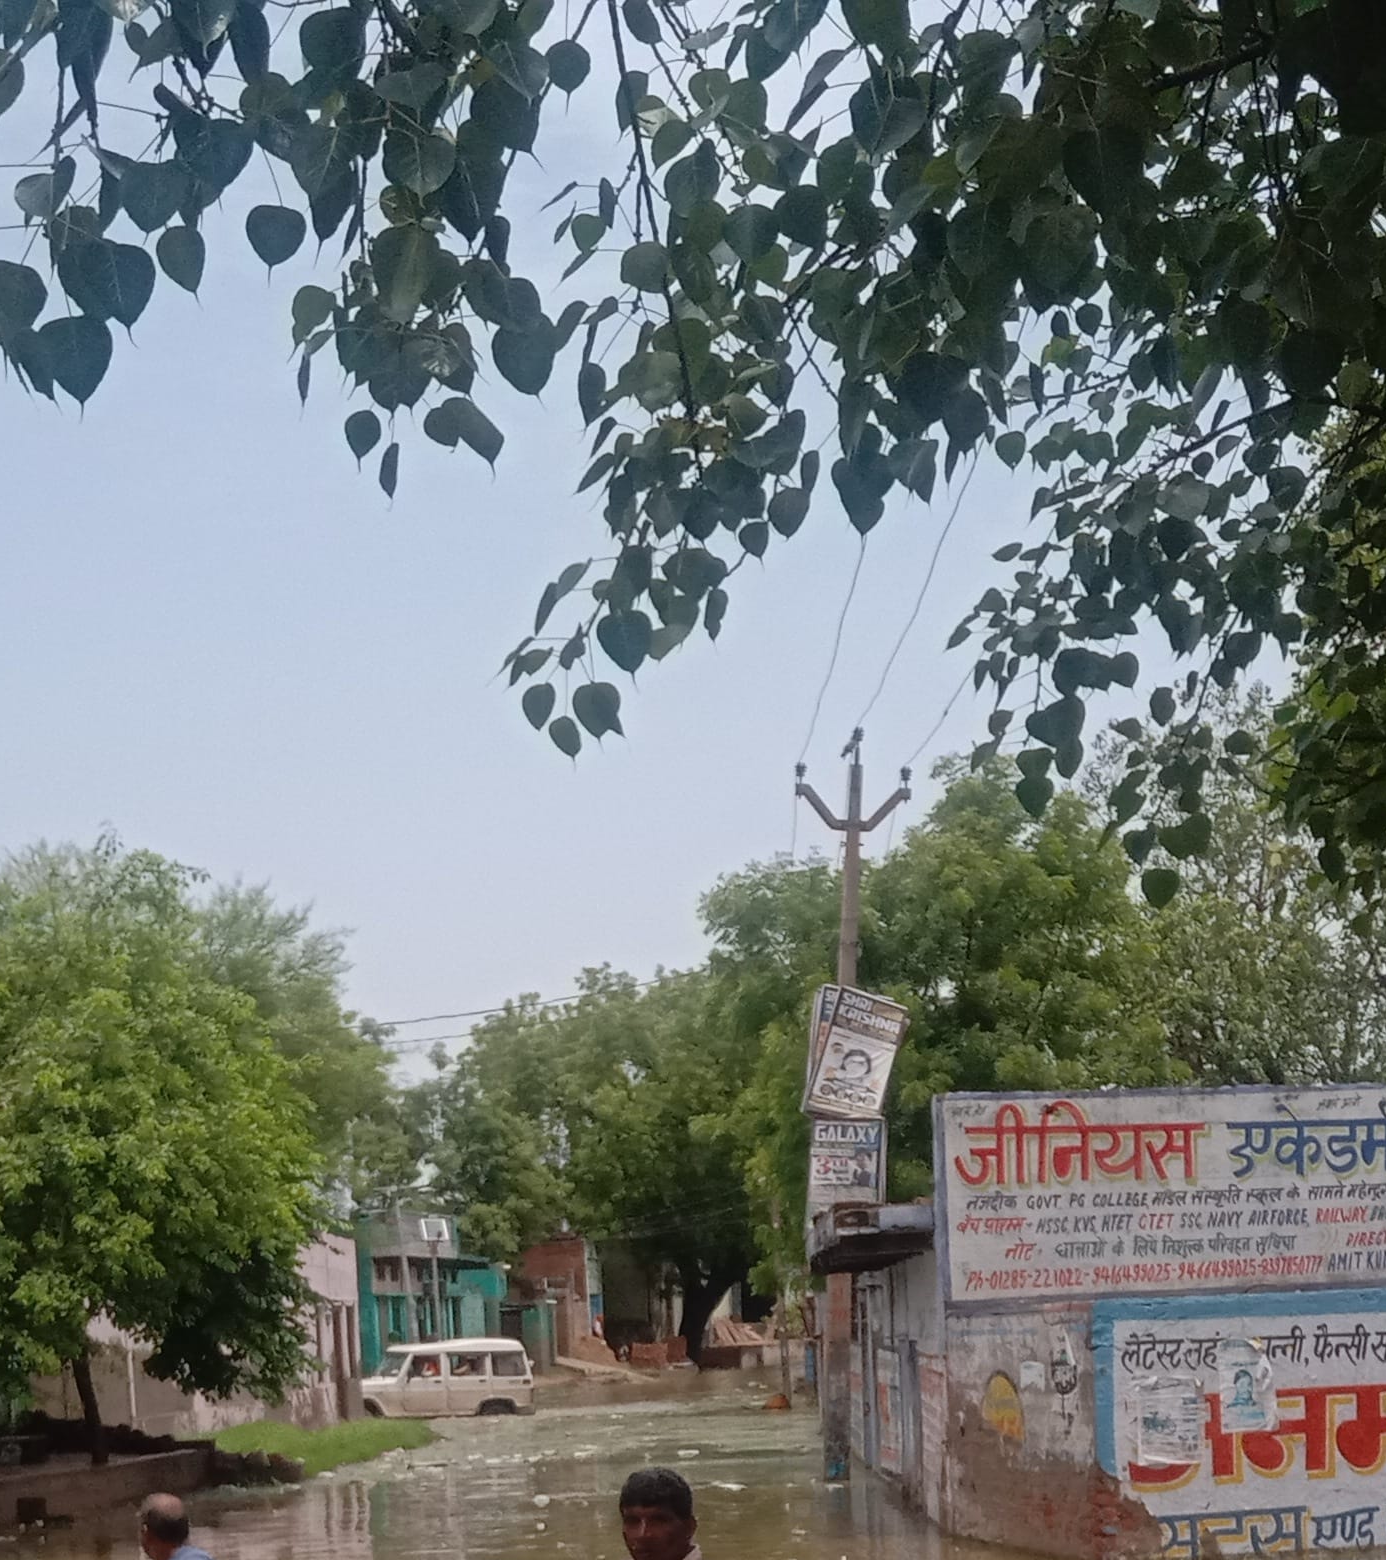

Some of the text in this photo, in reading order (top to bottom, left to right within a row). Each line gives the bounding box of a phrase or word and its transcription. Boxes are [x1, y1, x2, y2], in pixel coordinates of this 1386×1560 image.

[841, 991, 873, 1011] SHRI
[838, 1005, 902, 1034] KRISHNA
[814, 1125, 880, 1144] GALAXY
[954, 1100, 1206, 1186] जीनियस
[1069, 1193, 1085, 1208] PG
[1286, 1183, 1301, 1200] के
[1327, 1251, 1363, 1273] AMIT
